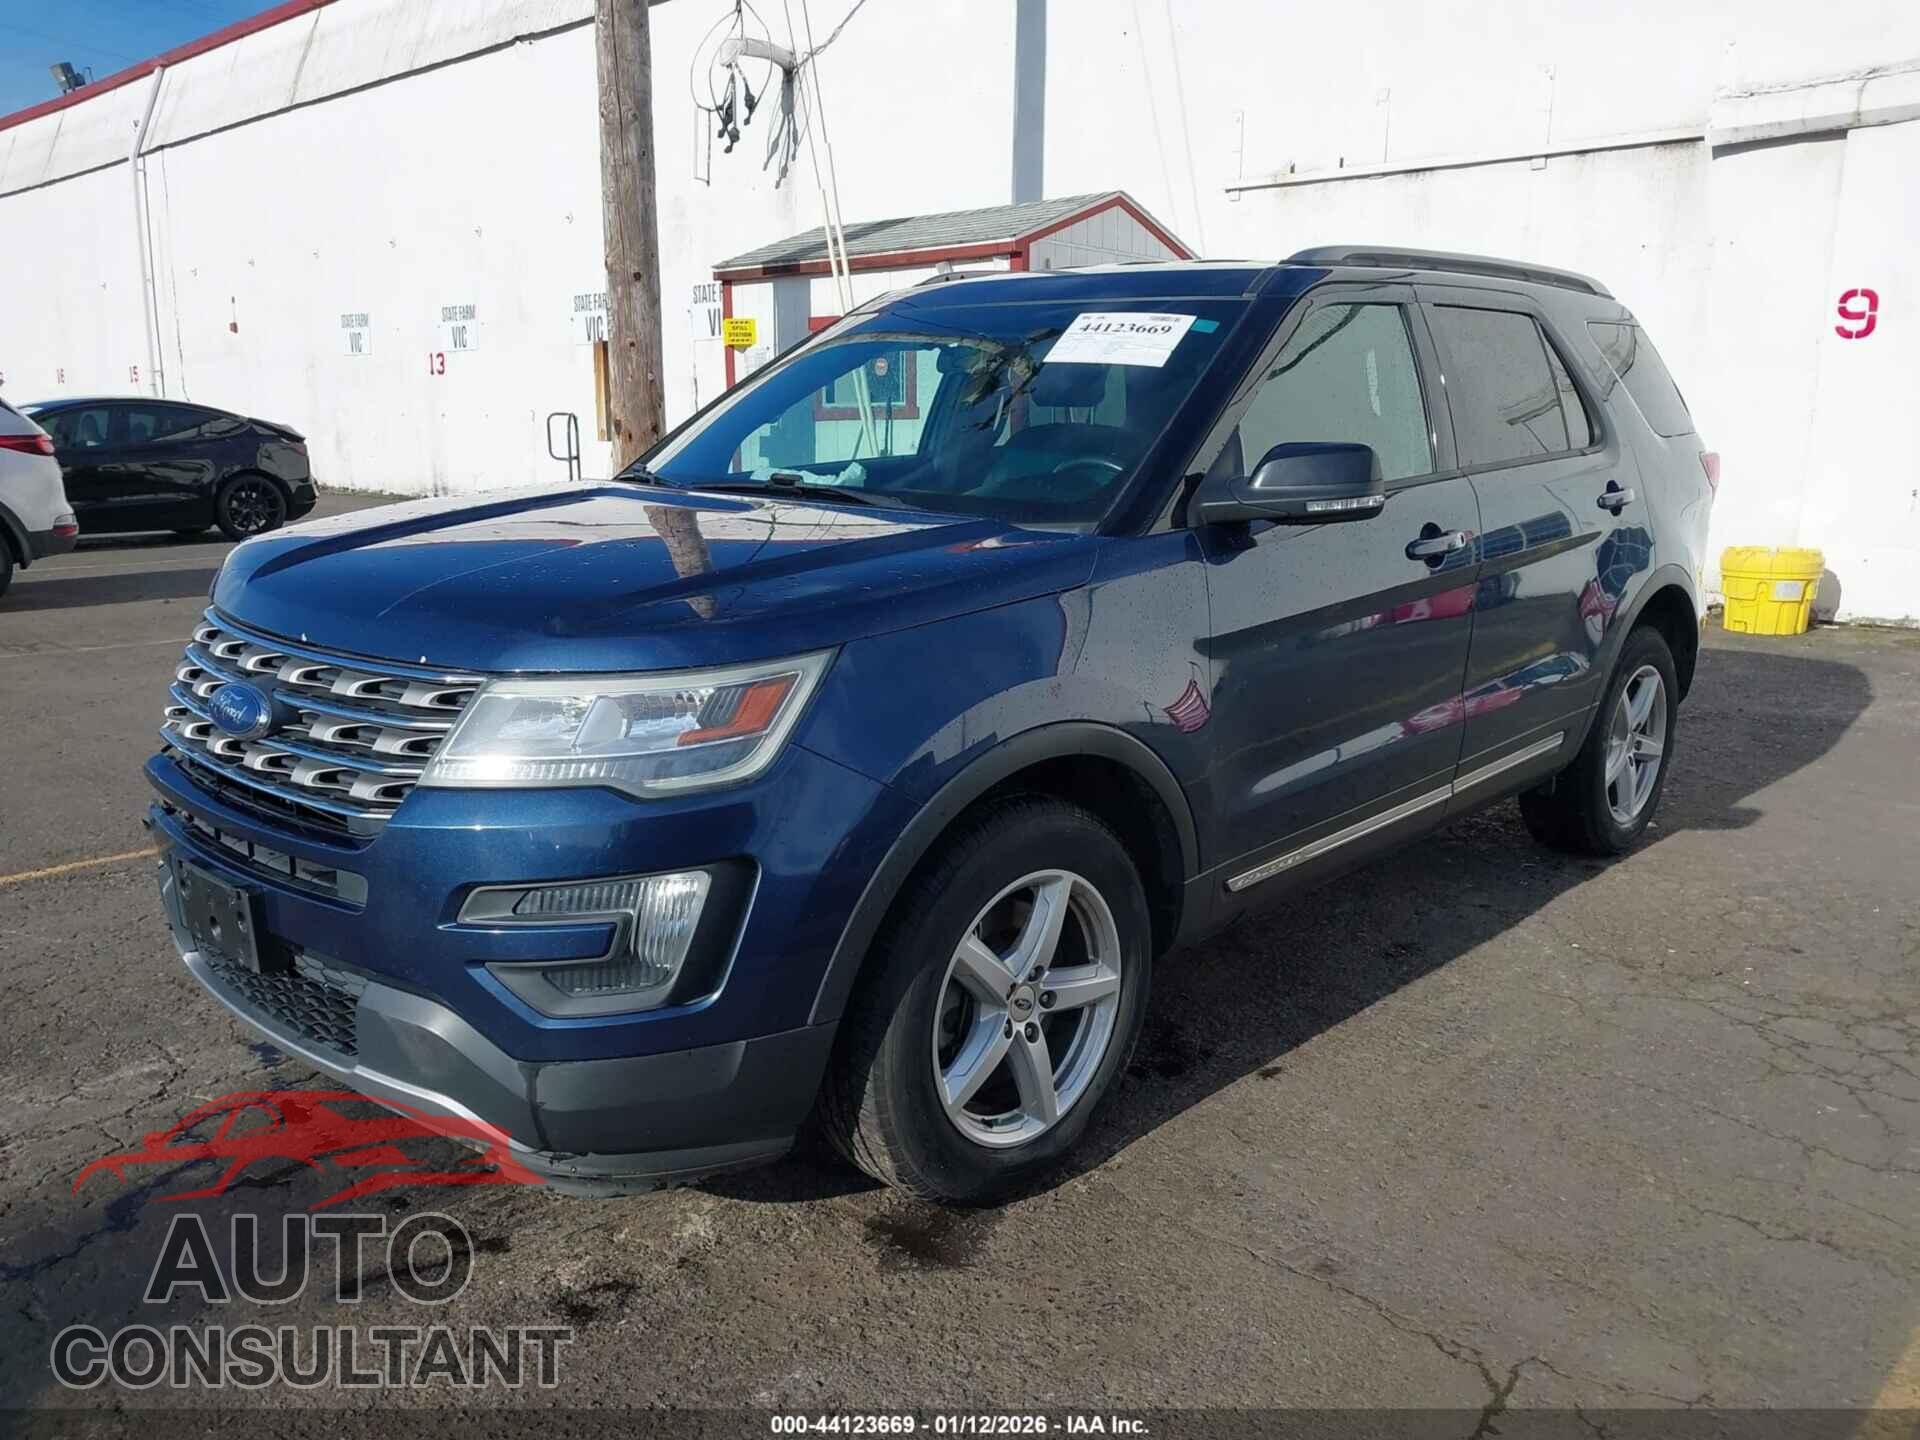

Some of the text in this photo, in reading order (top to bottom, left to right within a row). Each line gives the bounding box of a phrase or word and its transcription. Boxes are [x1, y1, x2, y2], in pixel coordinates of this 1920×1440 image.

[574, 294, 592, 312] STATE
[693, 283, 716, 304] STATE
[441, 304, 475, 321] STATE FARM
[707, 308, 721, 336] VI
[1835, 288, 1878, 339] 9
[452, 325, 467, 348] VIC
[585, 315, 604, 341] VIC
[1080, 323, 1173, 334] 44123669
[349, 332, 362, 352] VIC
[429, 352, 445, 375] 13
